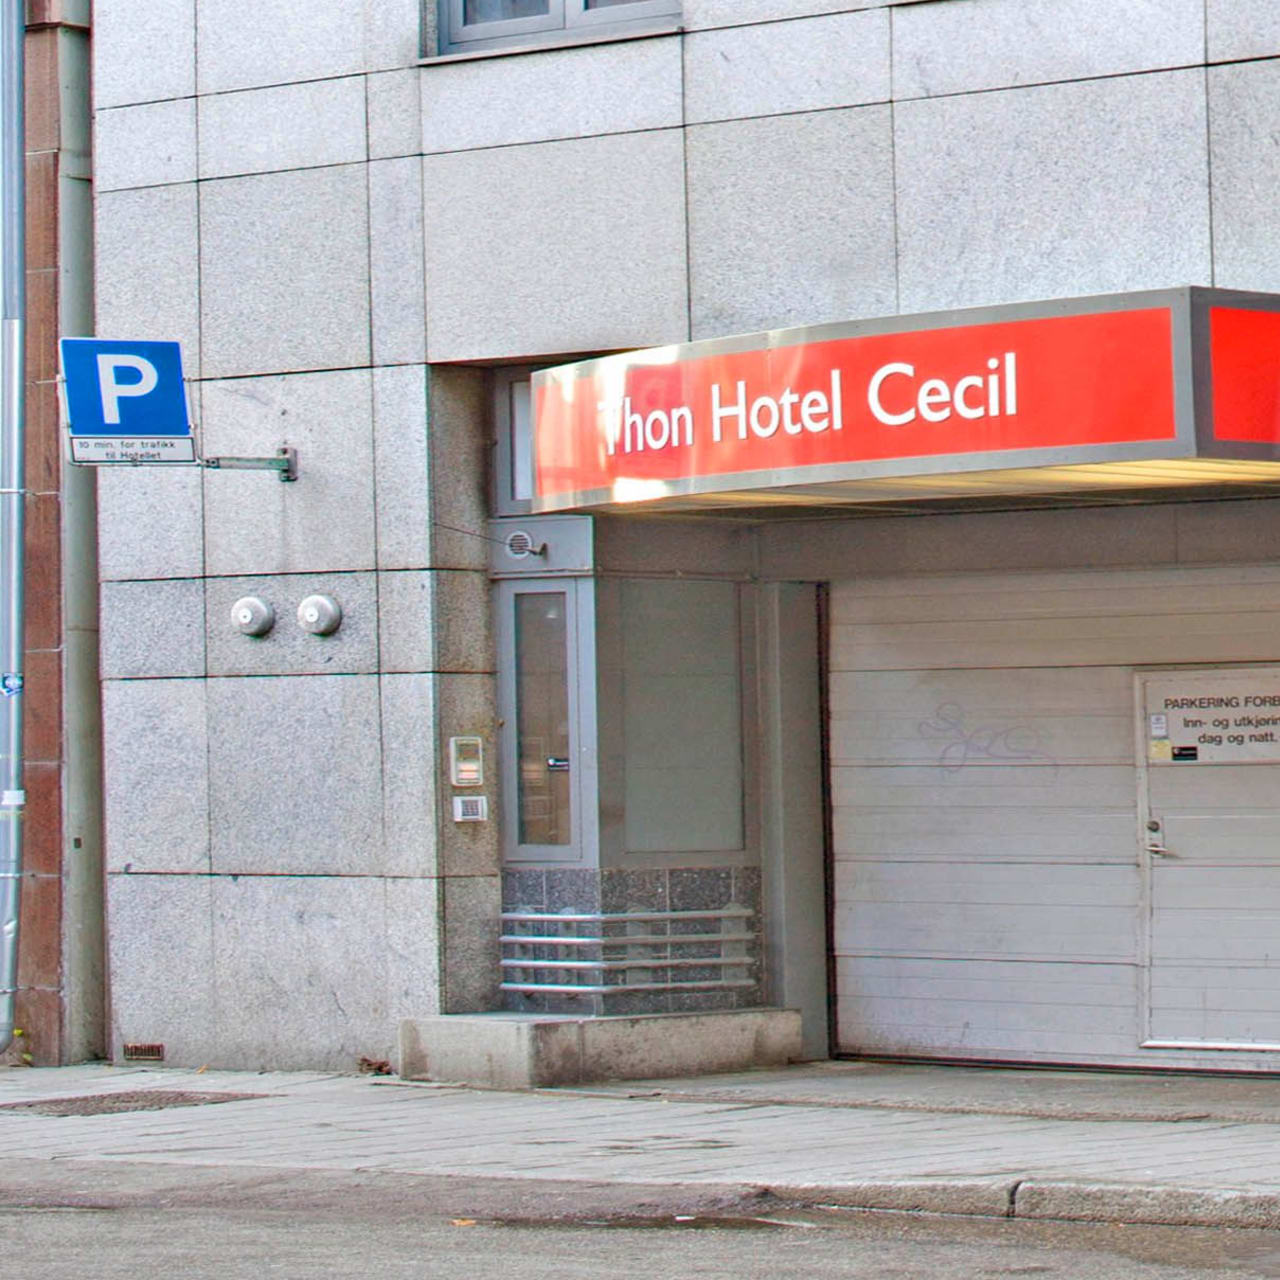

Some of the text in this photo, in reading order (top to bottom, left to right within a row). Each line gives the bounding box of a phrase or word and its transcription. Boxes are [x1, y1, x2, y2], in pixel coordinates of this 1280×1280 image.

[96, 353, 159, 425] P
[597, 352, 1018, 456] Thon Hotel Cecil
[120, 441, 135, 449] for
[141, 441, 176, 449] trafikk
[1164, 696, 1240, 710] PARKERING
[1212, 718, 1230, 730] og
[1197, 732, 1223, 746] dag
[1227, 733, 1245, 746] og
